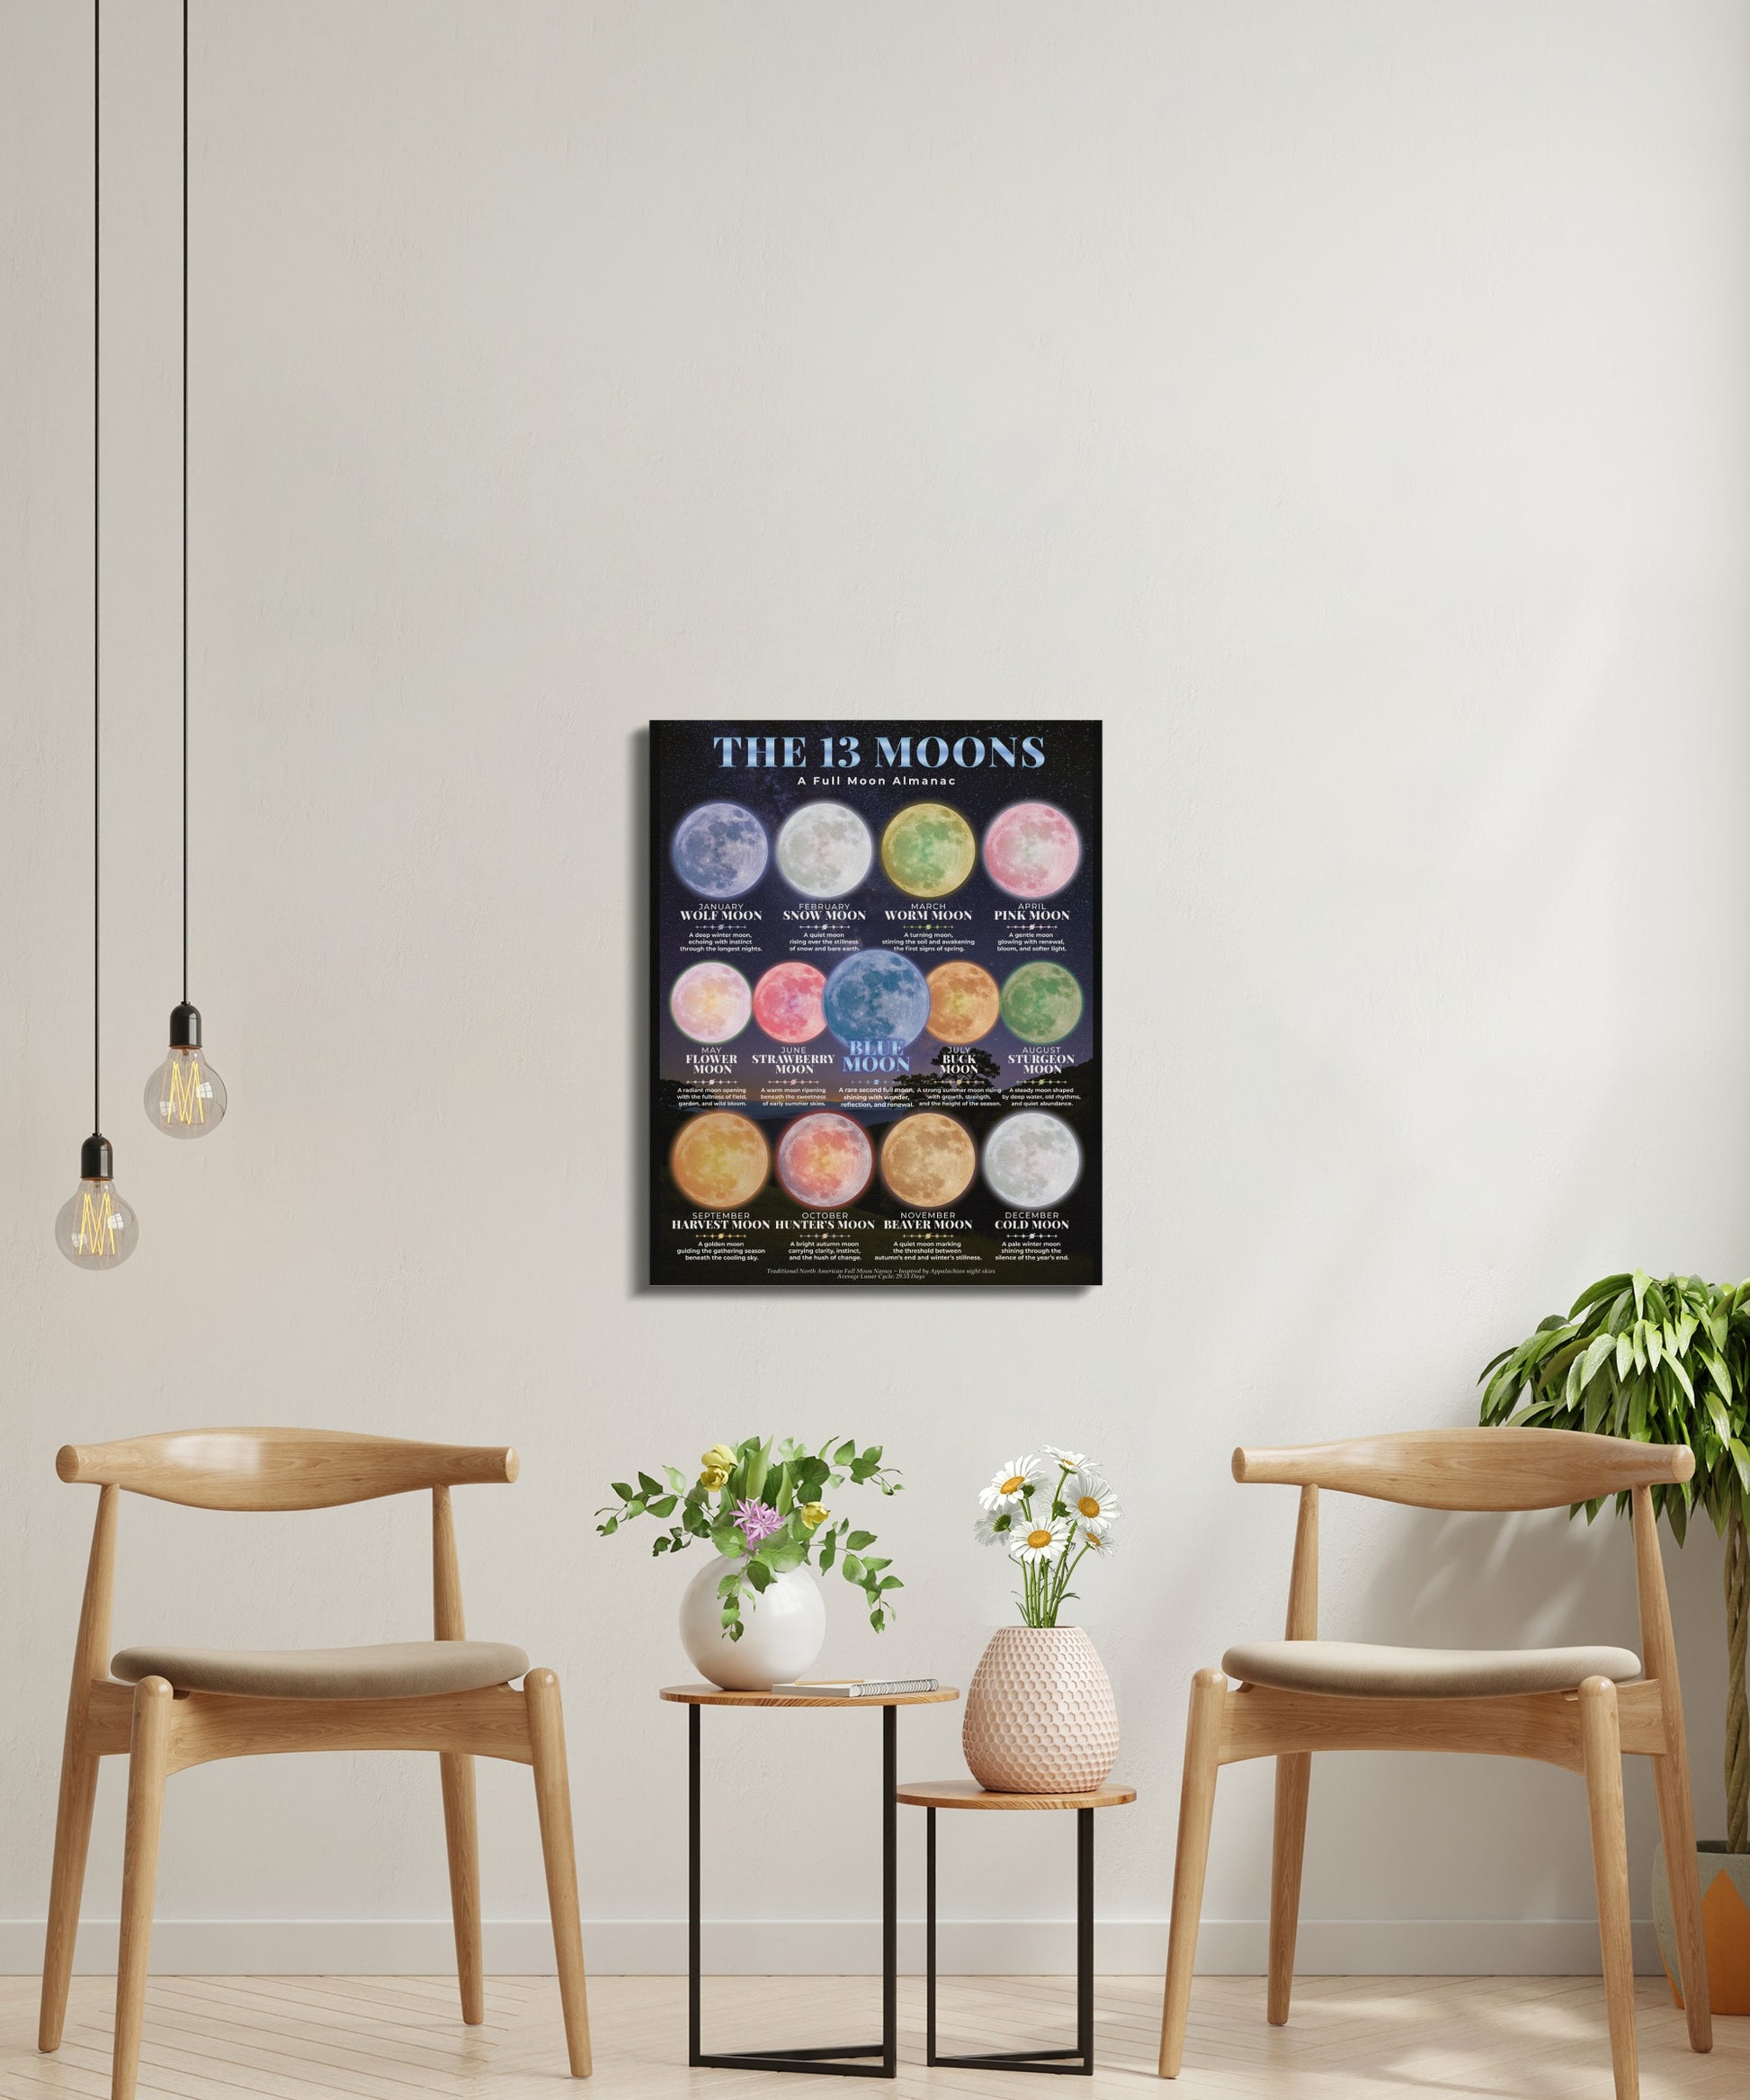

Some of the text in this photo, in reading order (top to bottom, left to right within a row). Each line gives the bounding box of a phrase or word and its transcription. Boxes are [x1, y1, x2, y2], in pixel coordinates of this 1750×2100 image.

[713, 736, 1046, 768] THE 13 MOONS
[797, 776, 956, 786] A Full Moon Almanac
[680, 911, 762, 921] WOLF MOON
[783, 911, 866, 921] SNOW MOON
[885, 911, 972, 920] WORM MOON
[994, 911, 1070, 920] PINK MOON
[850, 1041, 903, 1055] BLUE
[686, 1055, 737, 1063] FLOWER
[752, 1055, 835, 1063] STRAWBERRY
[943, 1055, 976, 1063] BUCK
[1008, 1055, 1074, 1063] STURGEON
[843, 1057, 910, 1072] MOON
[693, 1065, 732, 1074] MOON
[776, 1065, 814, 1074] MOON
[940, 1065, 978, 1074] MOON
[1023, 1065, 1062, 1074] MOON
[672, 1220, 770, 1229] HARVEST MOON
[776, 1220, 875, 1229] HUNTER'S MOON
[884, 1220, 972, 1229] BEAVER MOON
[995, 1220, 1069, 1229] COLD MOON
